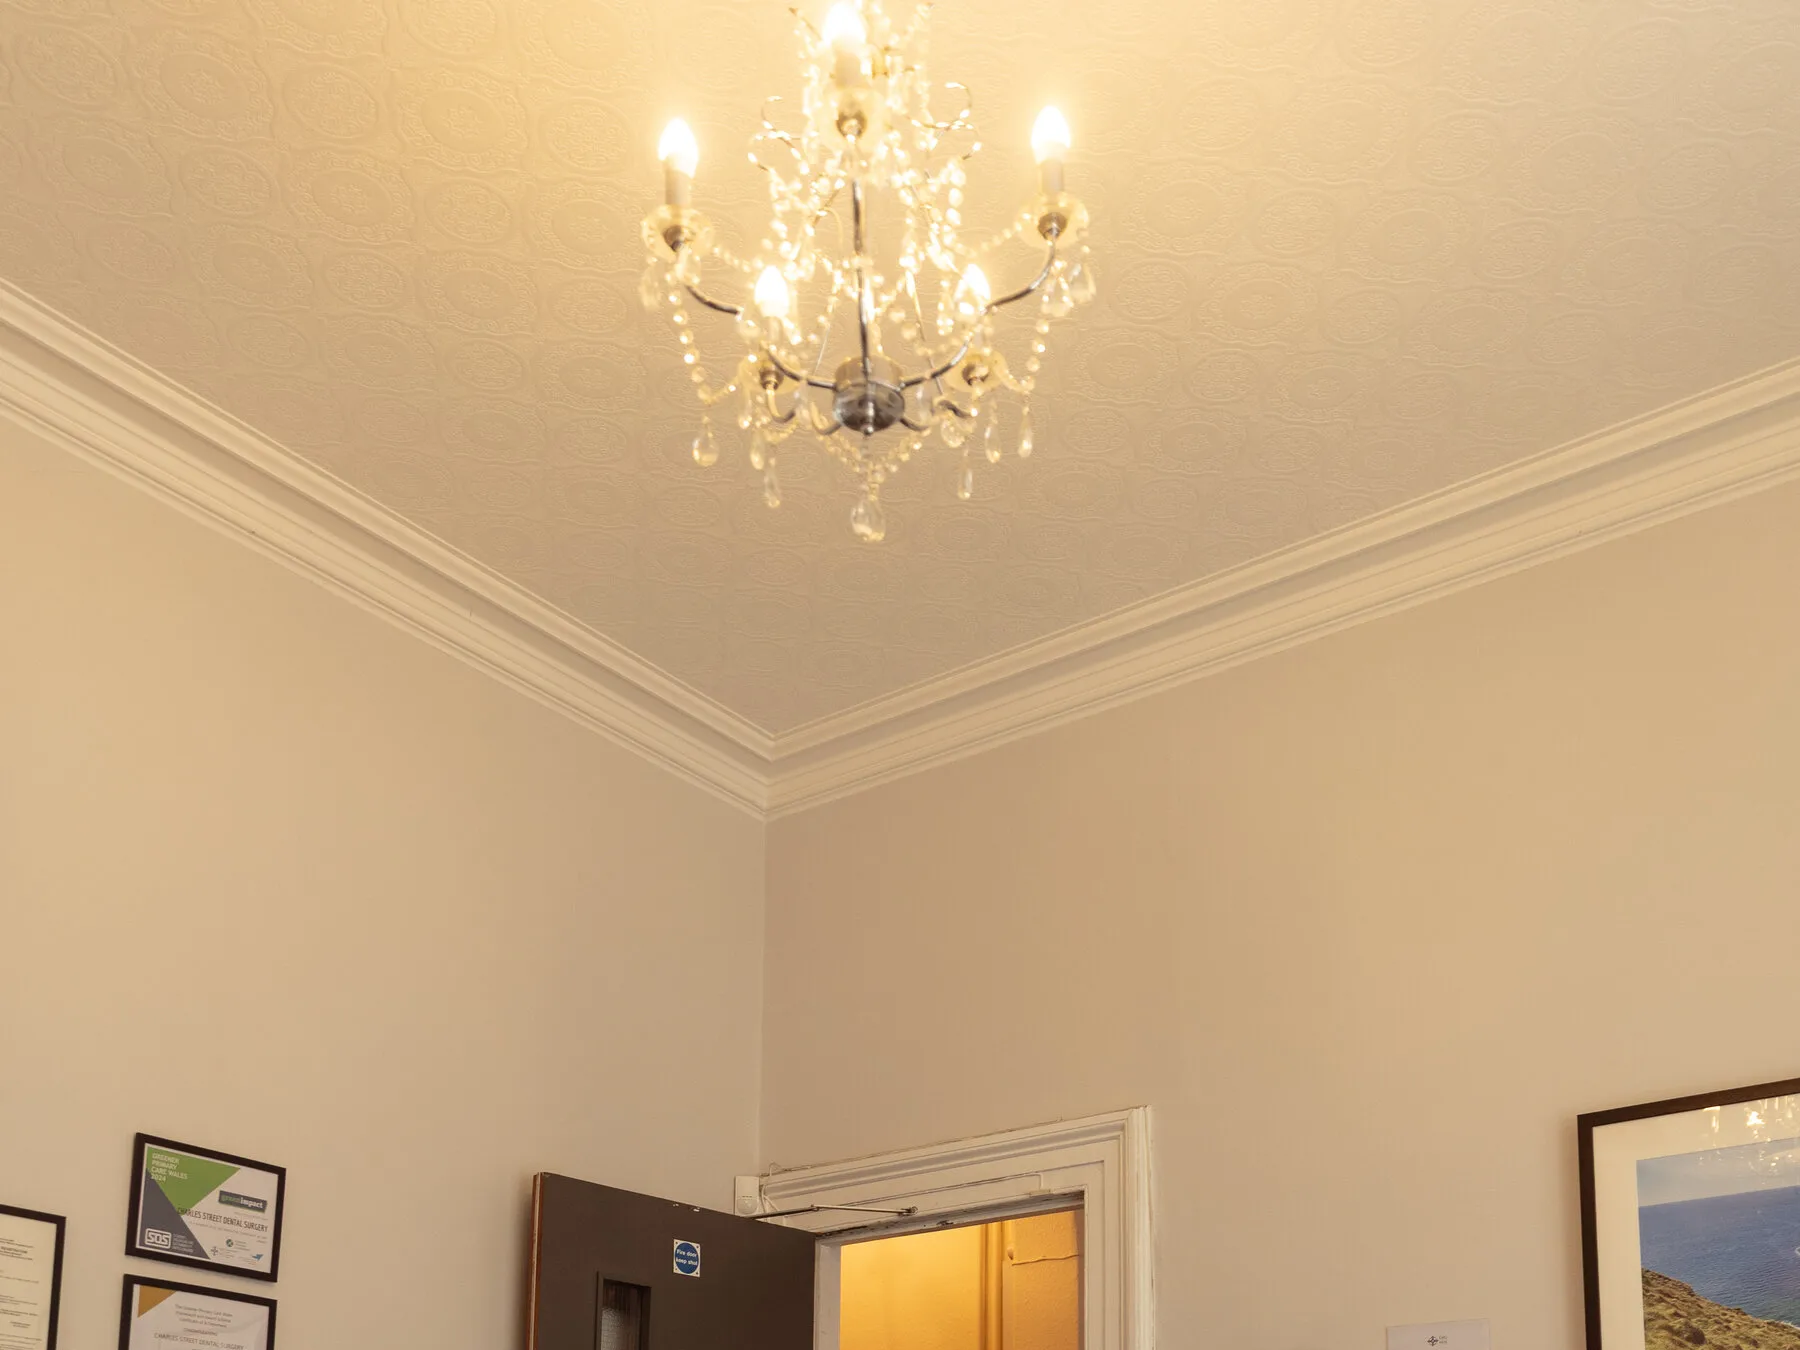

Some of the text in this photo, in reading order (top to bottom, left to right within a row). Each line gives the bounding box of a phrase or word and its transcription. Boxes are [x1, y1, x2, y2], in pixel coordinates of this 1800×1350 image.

[203, 1212, 223, 1223] STREET
[223, 1217, 243, 1228] DENTAL
[244, 1221, 268, 1232] SURGERY
[148, 1231, 168, 1245] SOS
